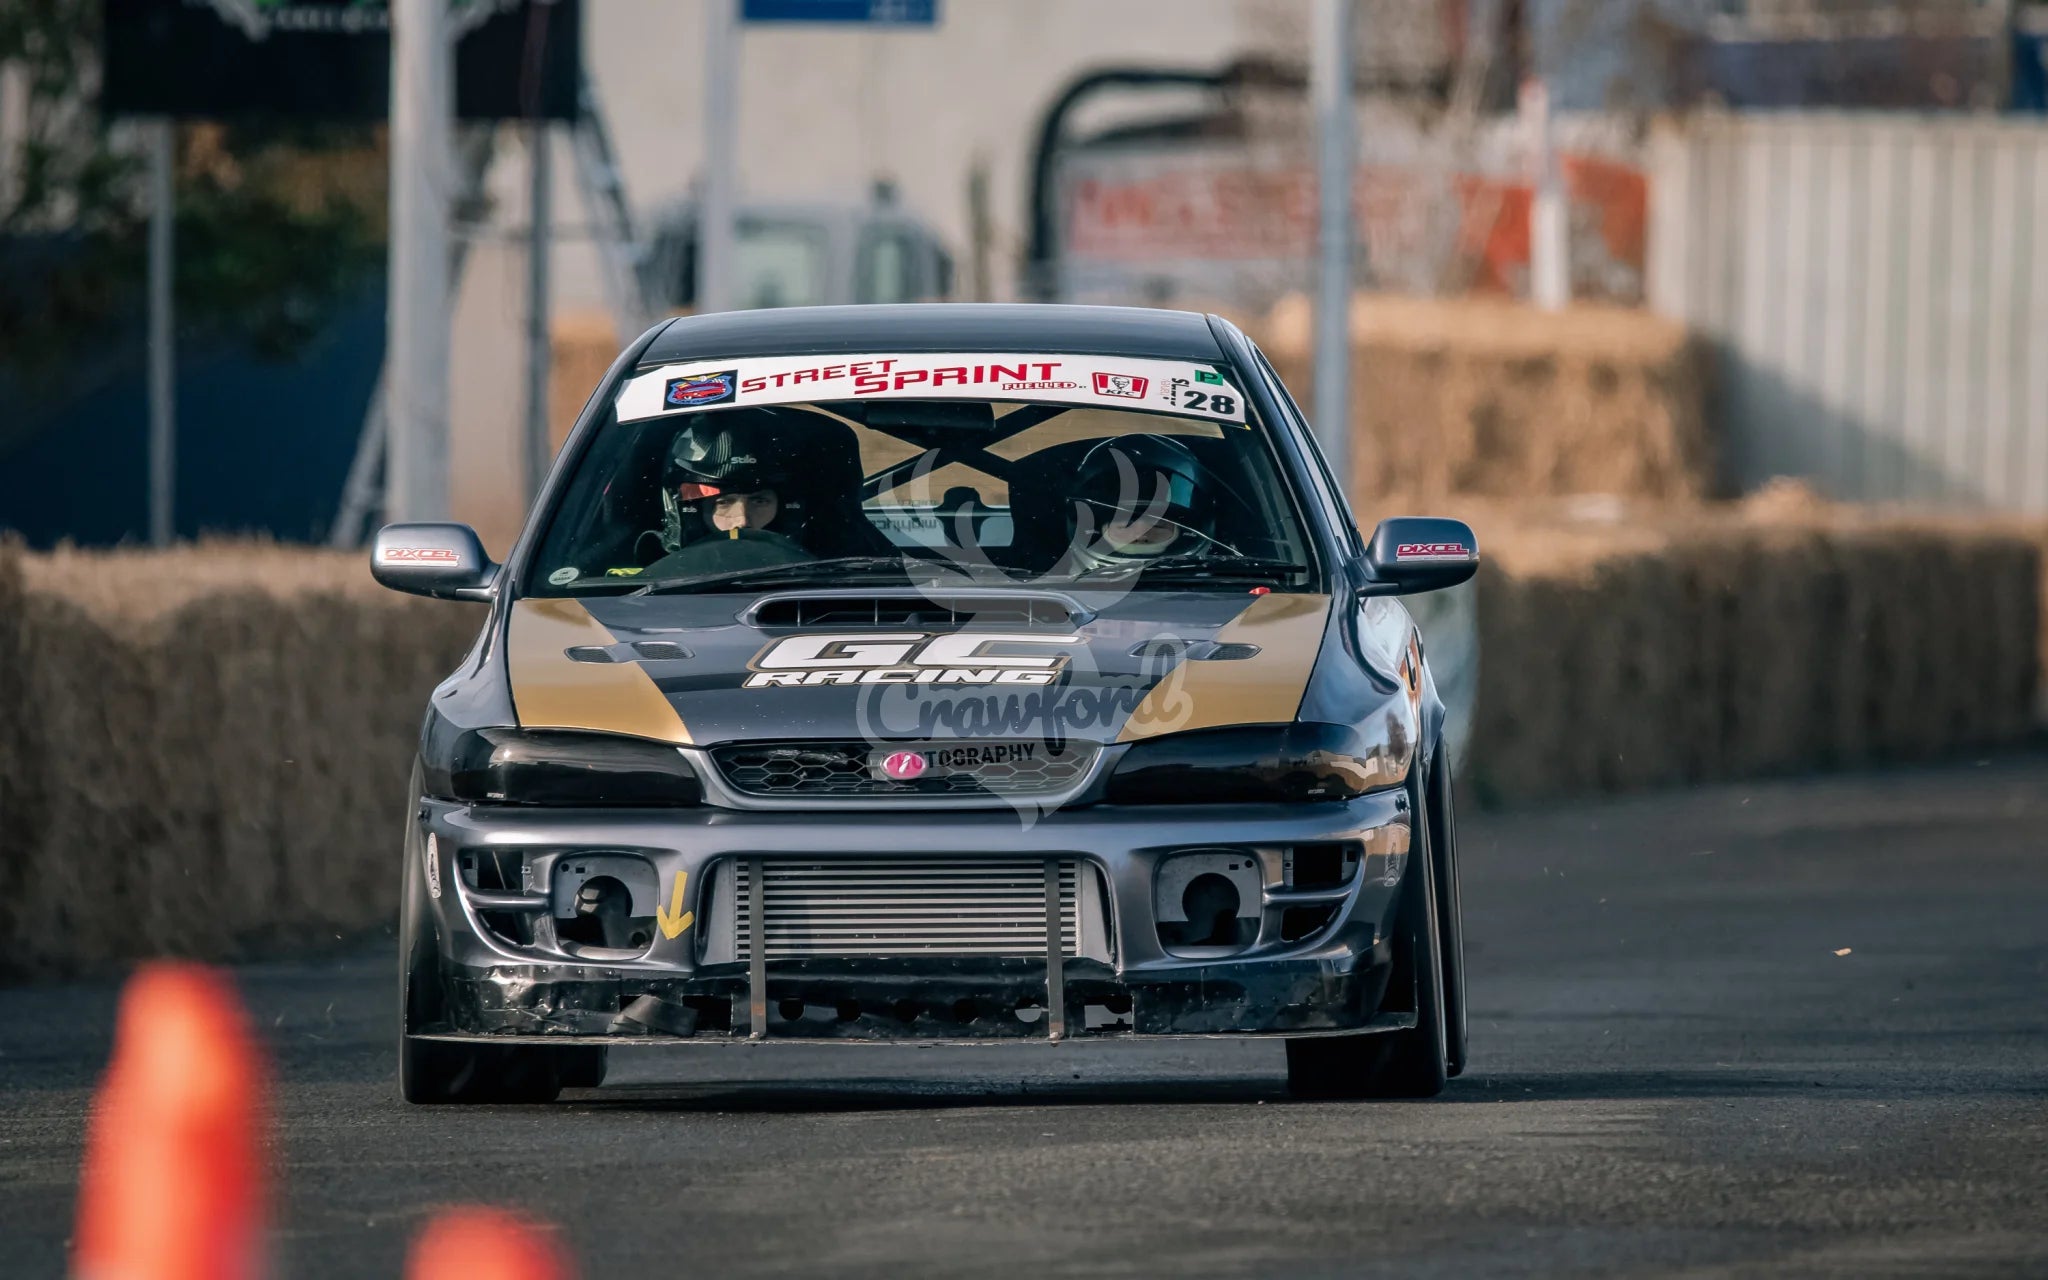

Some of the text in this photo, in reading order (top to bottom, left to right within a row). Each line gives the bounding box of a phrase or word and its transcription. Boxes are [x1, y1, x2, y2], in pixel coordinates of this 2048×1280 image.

[741, 359, 899, 394] STREET
[854, 362, 1062, 395] SPRINT
[1200, 371, 1218, 382] P
[1002, 381, 1077, 391] FUELLED
[1105, 389, 1135, 397] KFC
[1184, 390, 1236, 415] 28
[384, 548, 459, 561] DIXCEL
[1397, 544, 1469, 557] DIXCEL
[752, 632, 1086, 670] GC
[744, 668, 1059, 689] RACING
